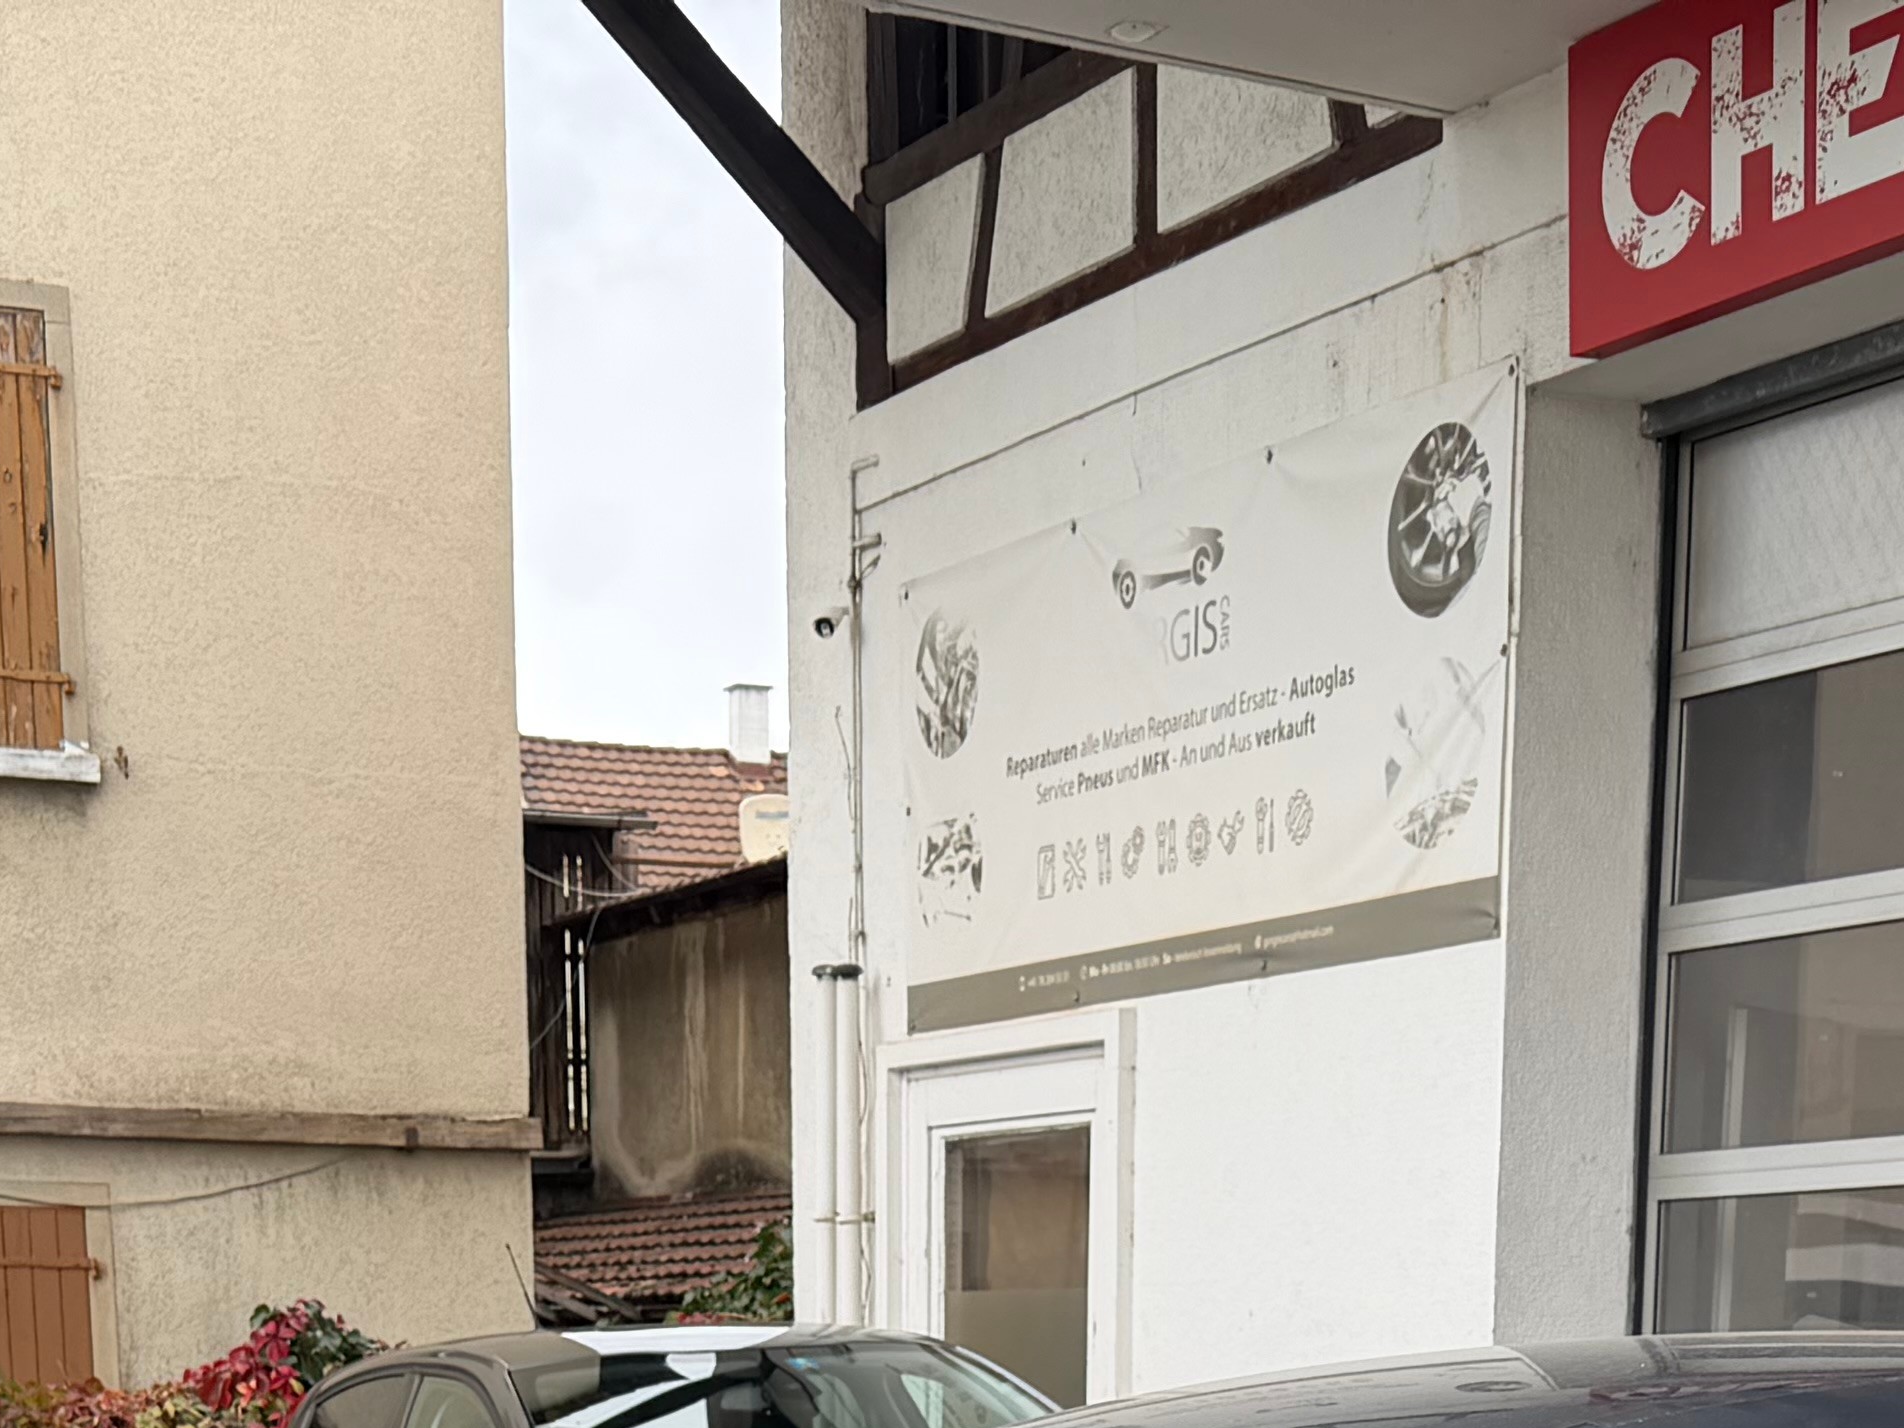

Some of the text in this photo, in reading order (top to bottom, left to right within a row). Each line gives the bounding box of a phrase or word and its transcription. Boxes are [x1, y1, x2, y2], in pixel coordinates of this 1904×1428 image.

[1006, 742, 1078, 780] Reparaturen
[1080, 733, 1099, 757] alle
[1102, 722, 1146, 751] Marken
[1148, 706, 1208, 744] Reparatur
[1211, 693, 1237, 723] und
[1239, 686, 1278, 716] Ersatz
[1289, 664, 1356, 701] Autoglas
[1036, 774, 1075, 805] Service
[1077, 767, 1114, 795] Pneus
[1116, 759, 1139, 785] und
[1141, 749, 1170, 778] MFK
[1179, 744, 1198, 768] An
[1200, 733, 1226, 763] und
[1228, 731, 1253, 756] Aus
[1254, 710, 1317, 749] verkauft
